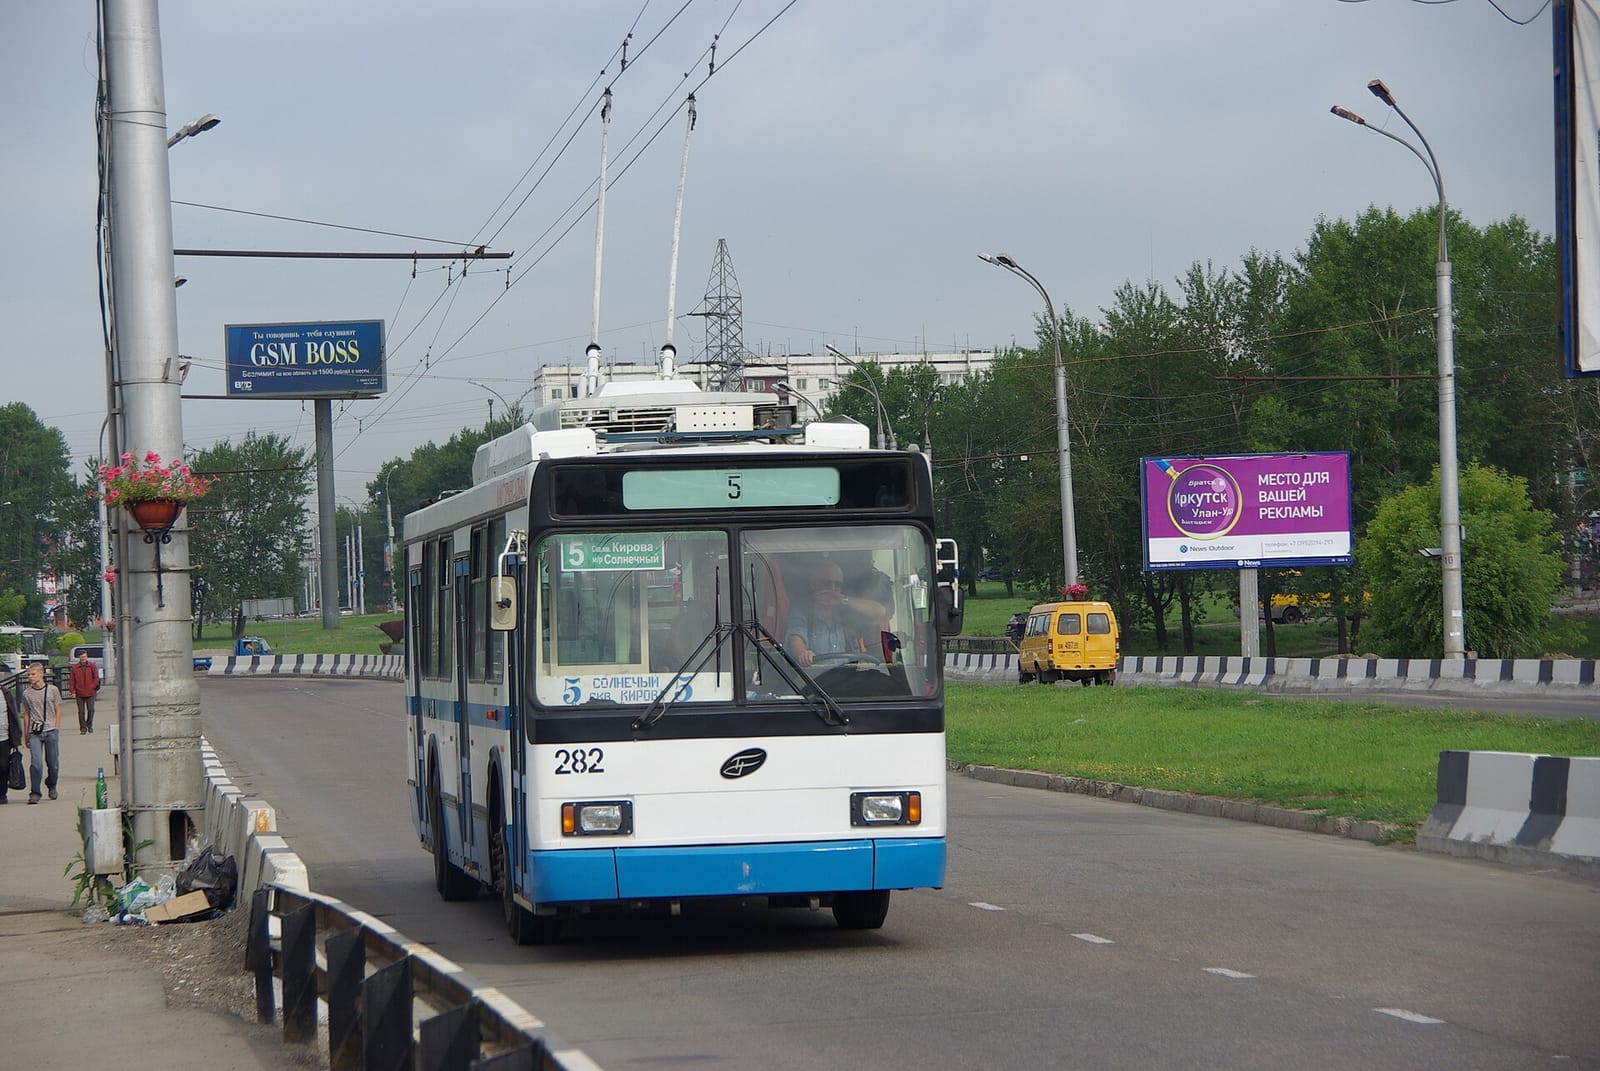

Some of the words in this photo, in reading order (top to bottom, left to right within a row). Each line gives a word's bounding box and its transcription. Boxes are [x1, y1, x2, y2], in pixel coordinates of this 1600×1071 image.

[253, 331, 264, 339] Ты
[306, 329, 323, 338] тебя
[251, 342, 298, 366] GSM
[305, 340, 360, 365] BOSS
[242, 370, 275, 378] Безлимит
[728, 475, 741, 499] 5
[1258, 473, 1301, 486] МЕСТО
[1302, 472, 1330, 487] ДЛЯ
[1174, 491, 1228, 508] Иркутск
[1258, 487, 1306, 503] ВАШЕЙ
[1259, 505, 1323, 519] РЕКЛАМЫ
[568, 541, 585, 566] 5
[612, 542, 654, 554] Кирова
[604, 553, 659, 565] Солнечный
[563, 678, 582, 704] 5
[674, 676, 693, 702] 5
[554, 748, 605, 775] 282
